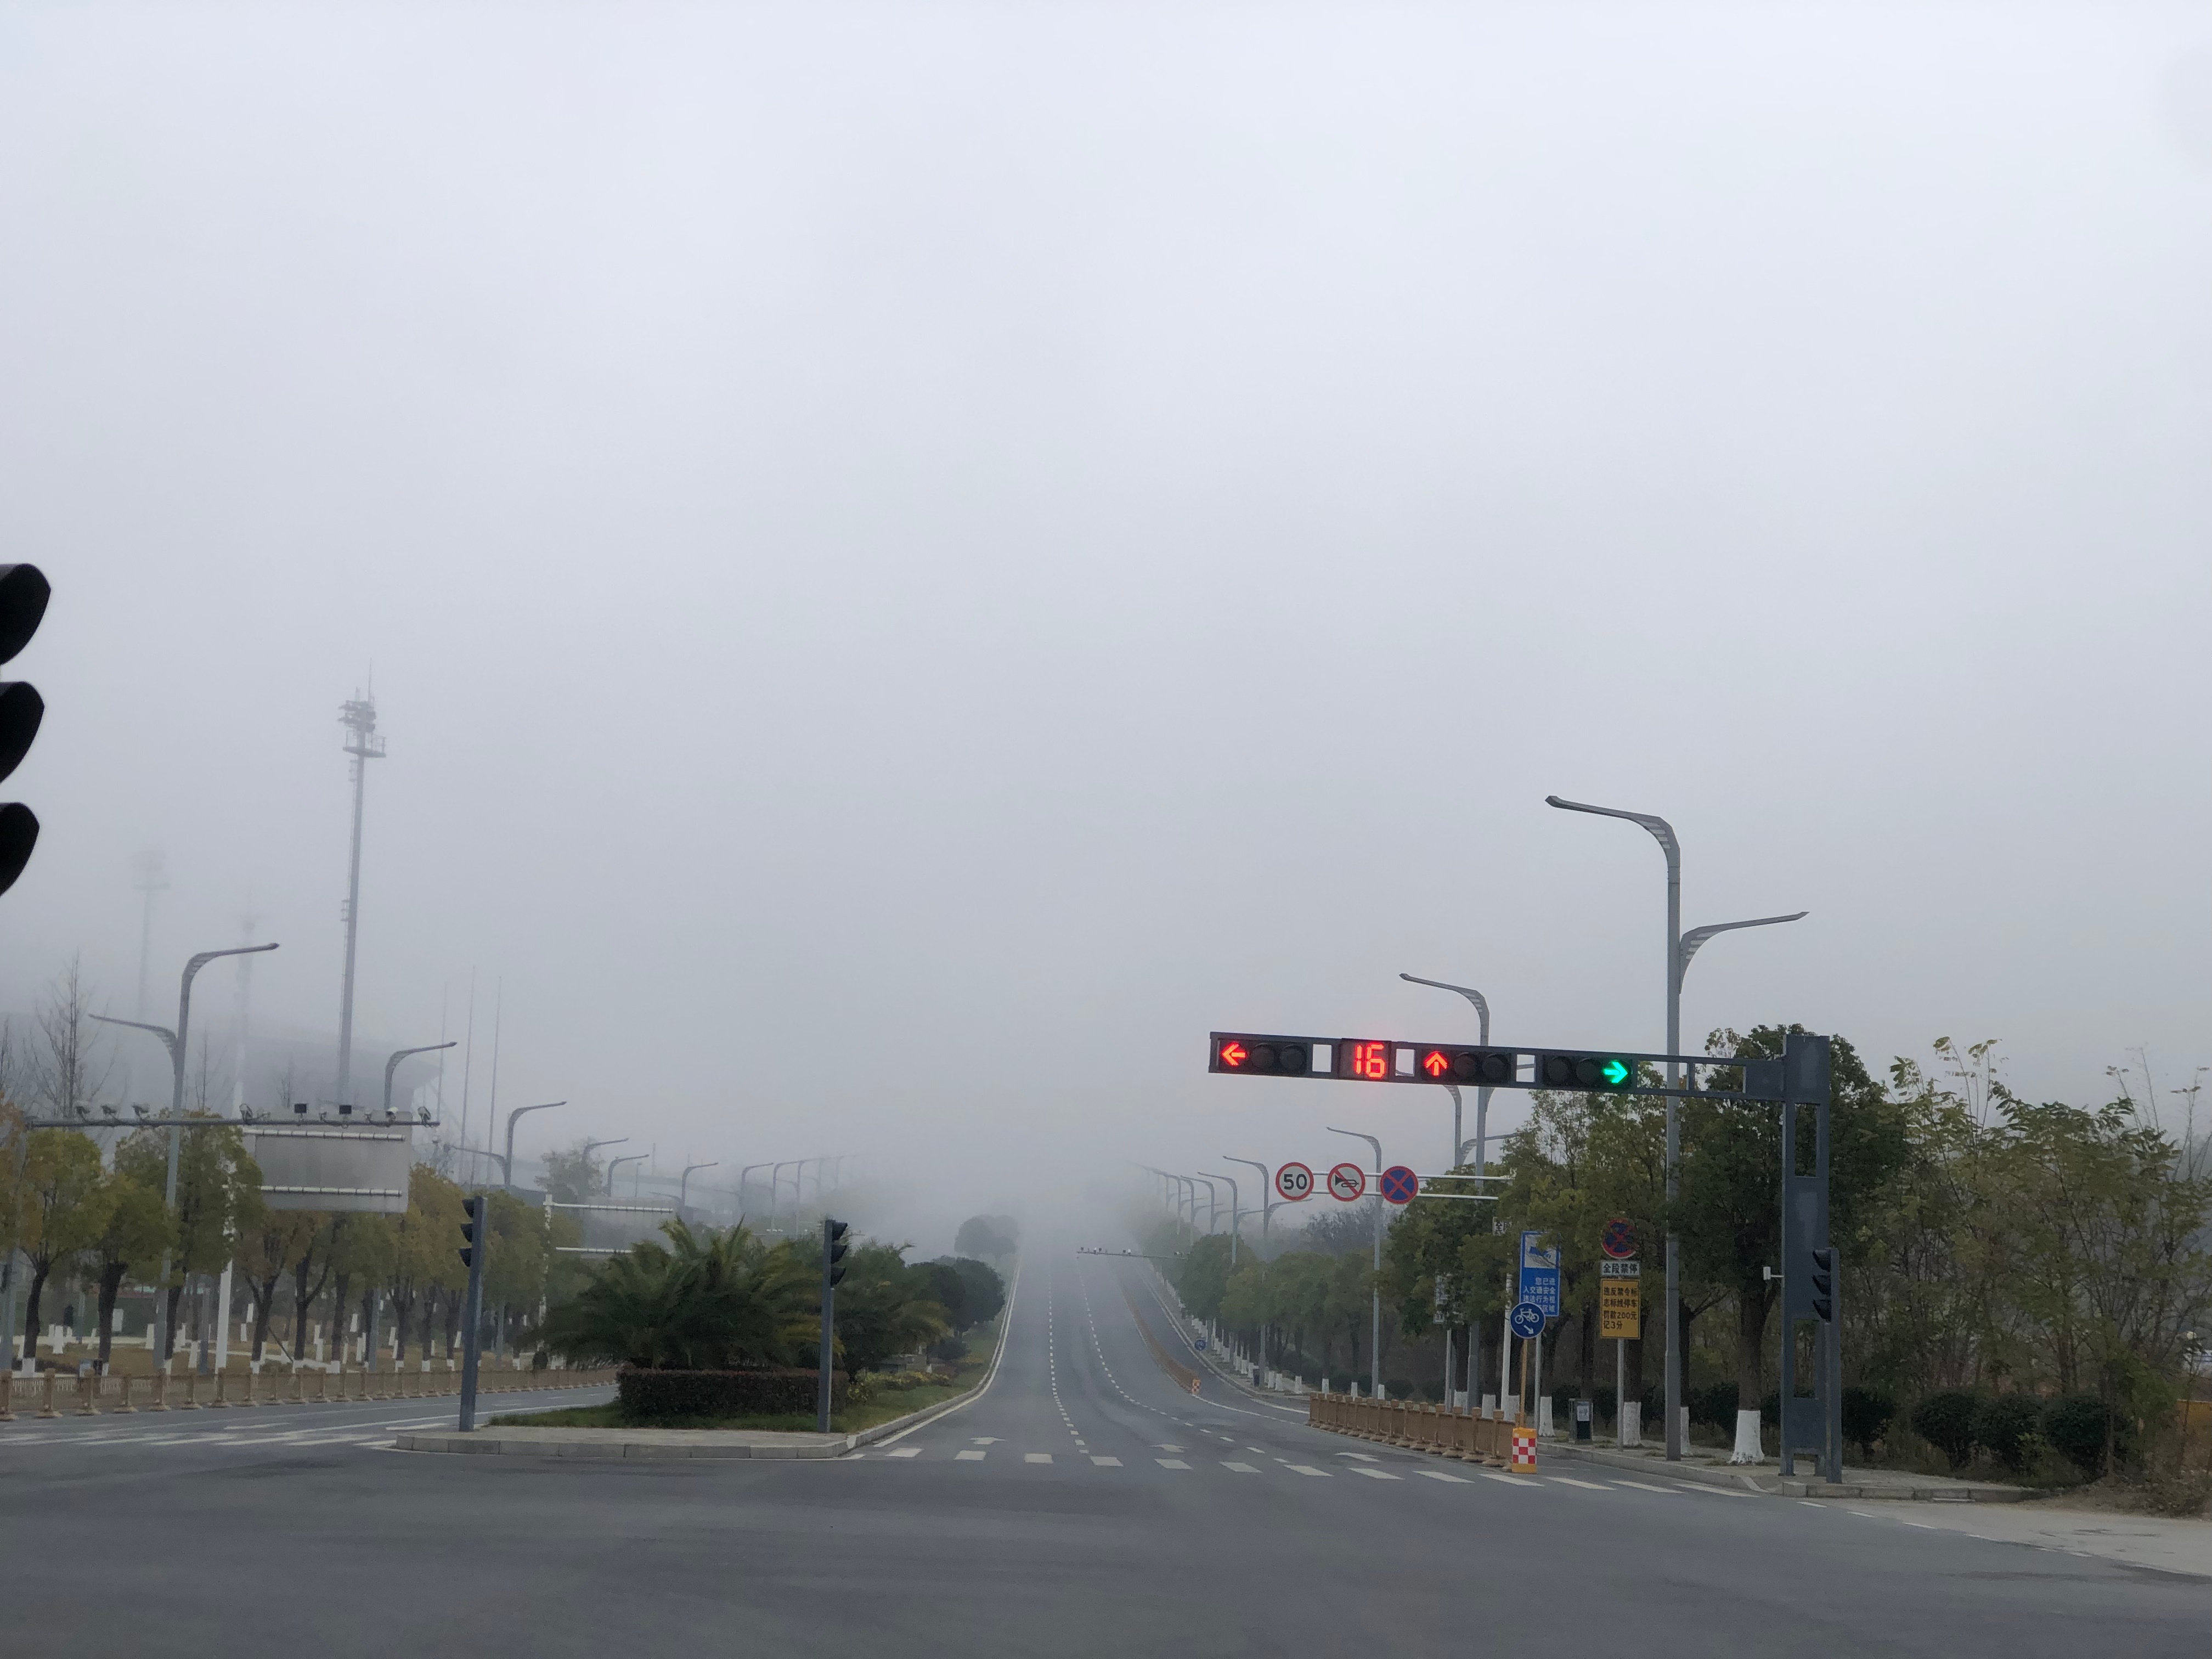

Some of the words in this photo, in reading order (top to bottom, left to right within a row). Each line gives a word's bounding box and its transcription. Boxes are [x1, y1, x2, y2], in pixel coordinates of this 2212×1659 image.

[1356, 1043, 1386, 1079] 16
[1284, 1173, 1307, 1190] 50
[1603, 1263, 1638, 1274] 全段禁停
[1523, 1286, 1556, 1294] 入交通安全
[1604, 1286, 1638, 1296] 违反禁令标
[1604, 1298, 1638, 1308] 志标线停车
[1604, 1310, 1638, 1320] 罚款200元
[1604, 1321, 1623, 1329] 记3分
